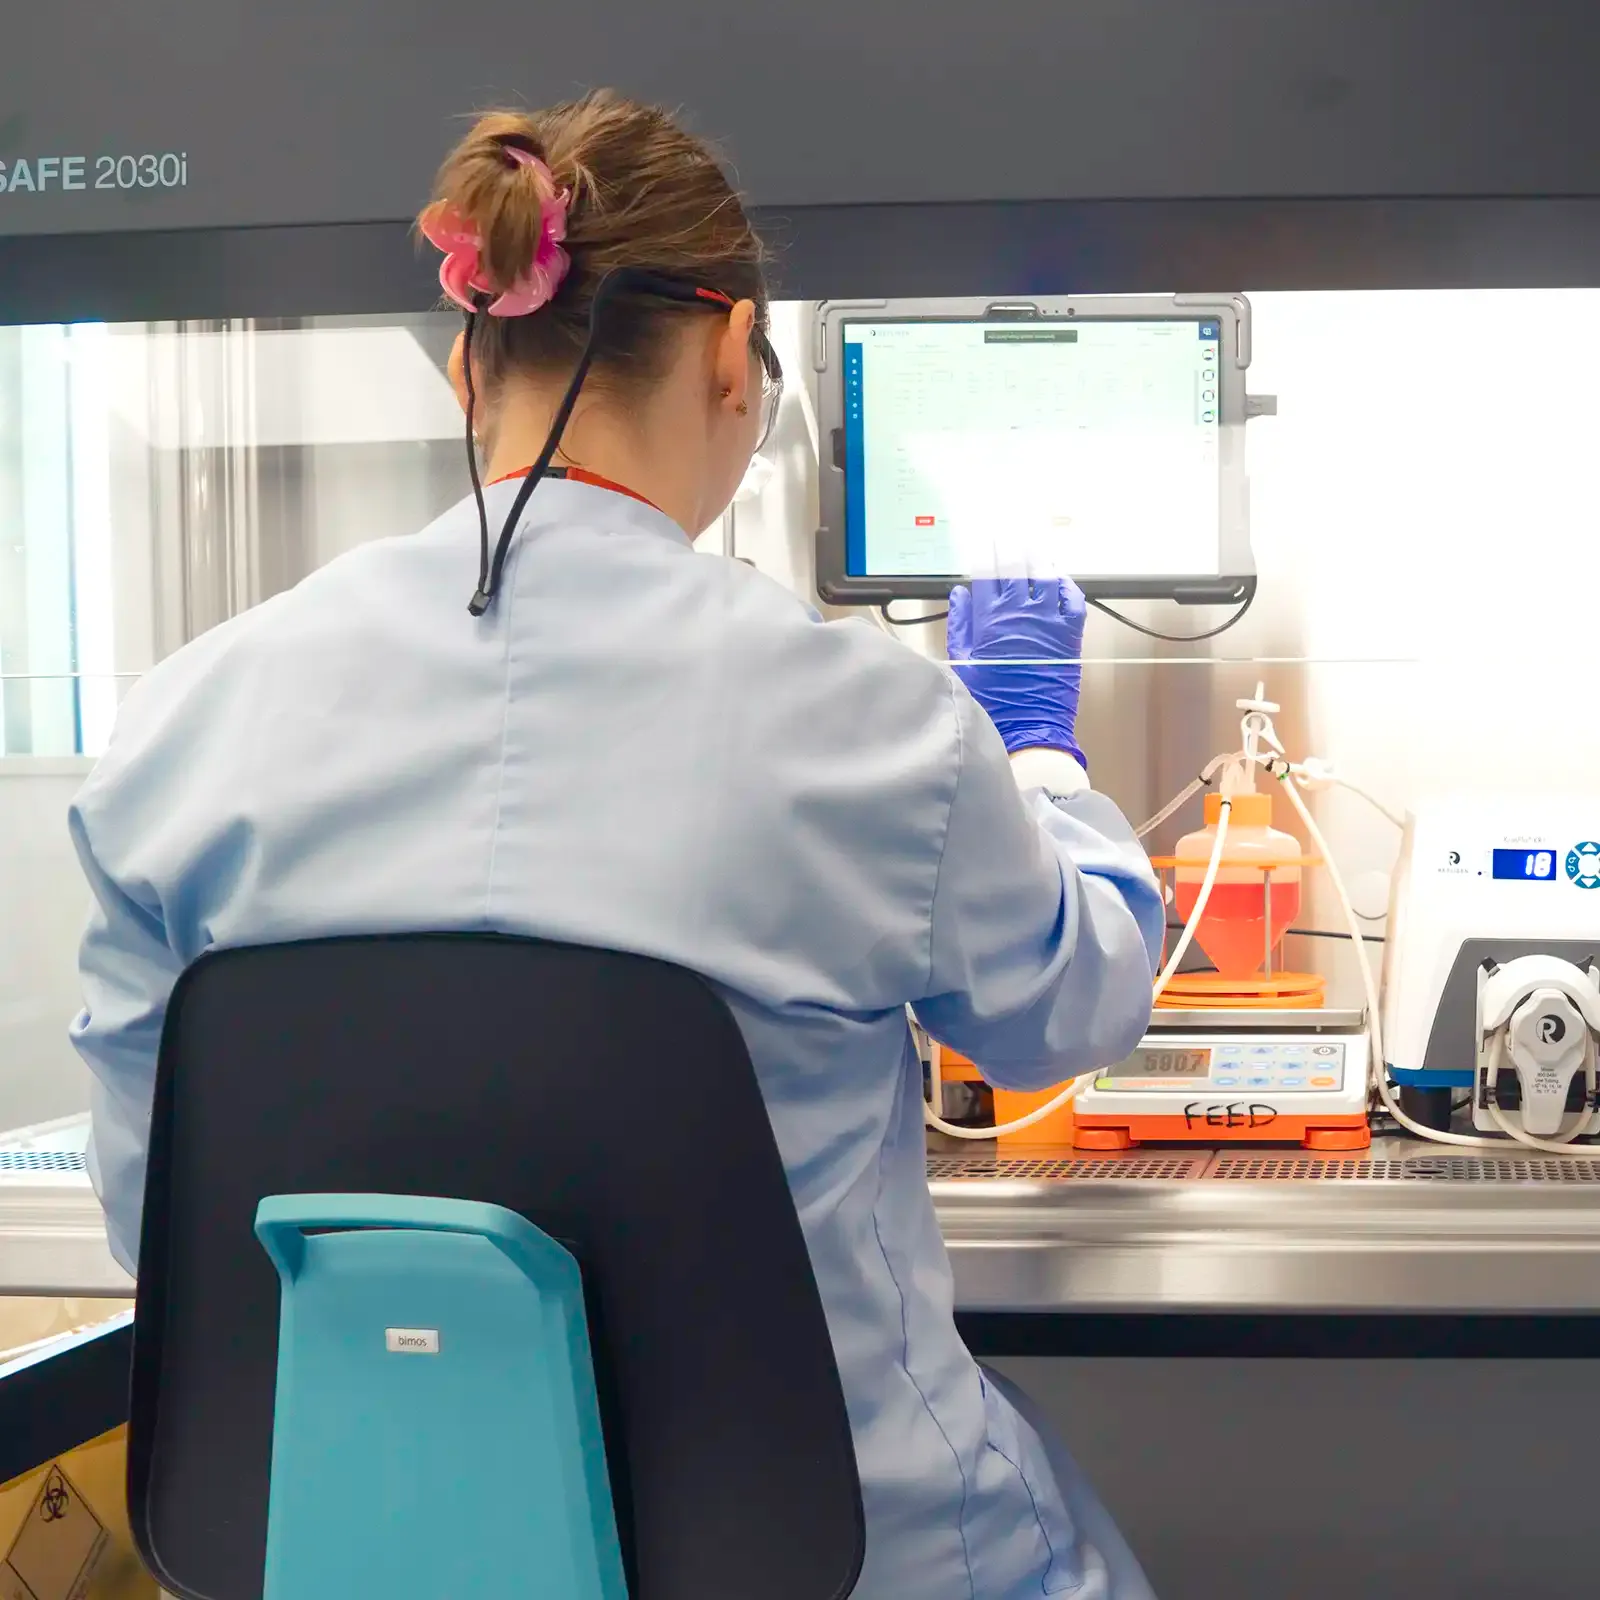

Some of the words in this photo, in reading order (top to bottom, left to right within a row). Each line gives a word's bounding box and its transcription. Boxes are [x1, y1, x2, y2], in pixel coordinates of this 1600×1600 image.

[95, 152, 187, 189] 2030i
[1525, 852, 1552, 877] 18
[1184, 1102, 1277, 1130] FEED
[398, 1336, 428, 1347] bimos
